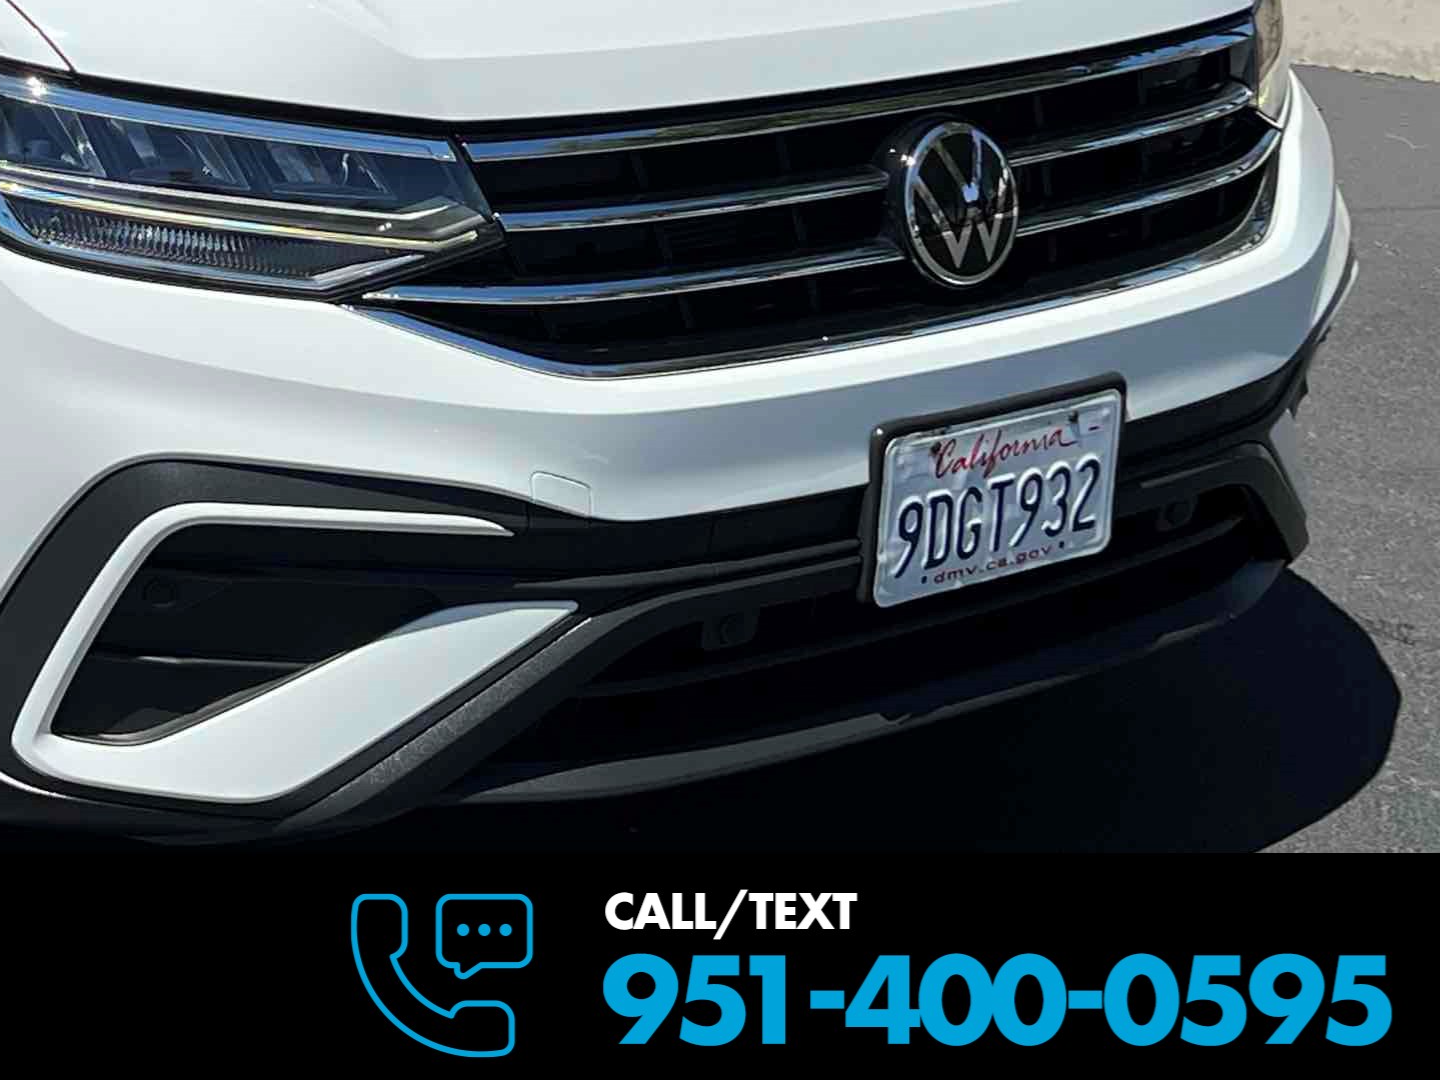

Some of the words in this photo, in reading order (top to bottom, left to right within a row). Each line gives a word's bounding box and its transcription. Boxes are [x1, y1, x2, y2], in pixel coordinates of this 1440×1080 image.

[934, 427, 1078, 478] California
[891, 453, 1102, 579] 9DGT932
[933, 543, 1053, 585] dmv.ca.gov
